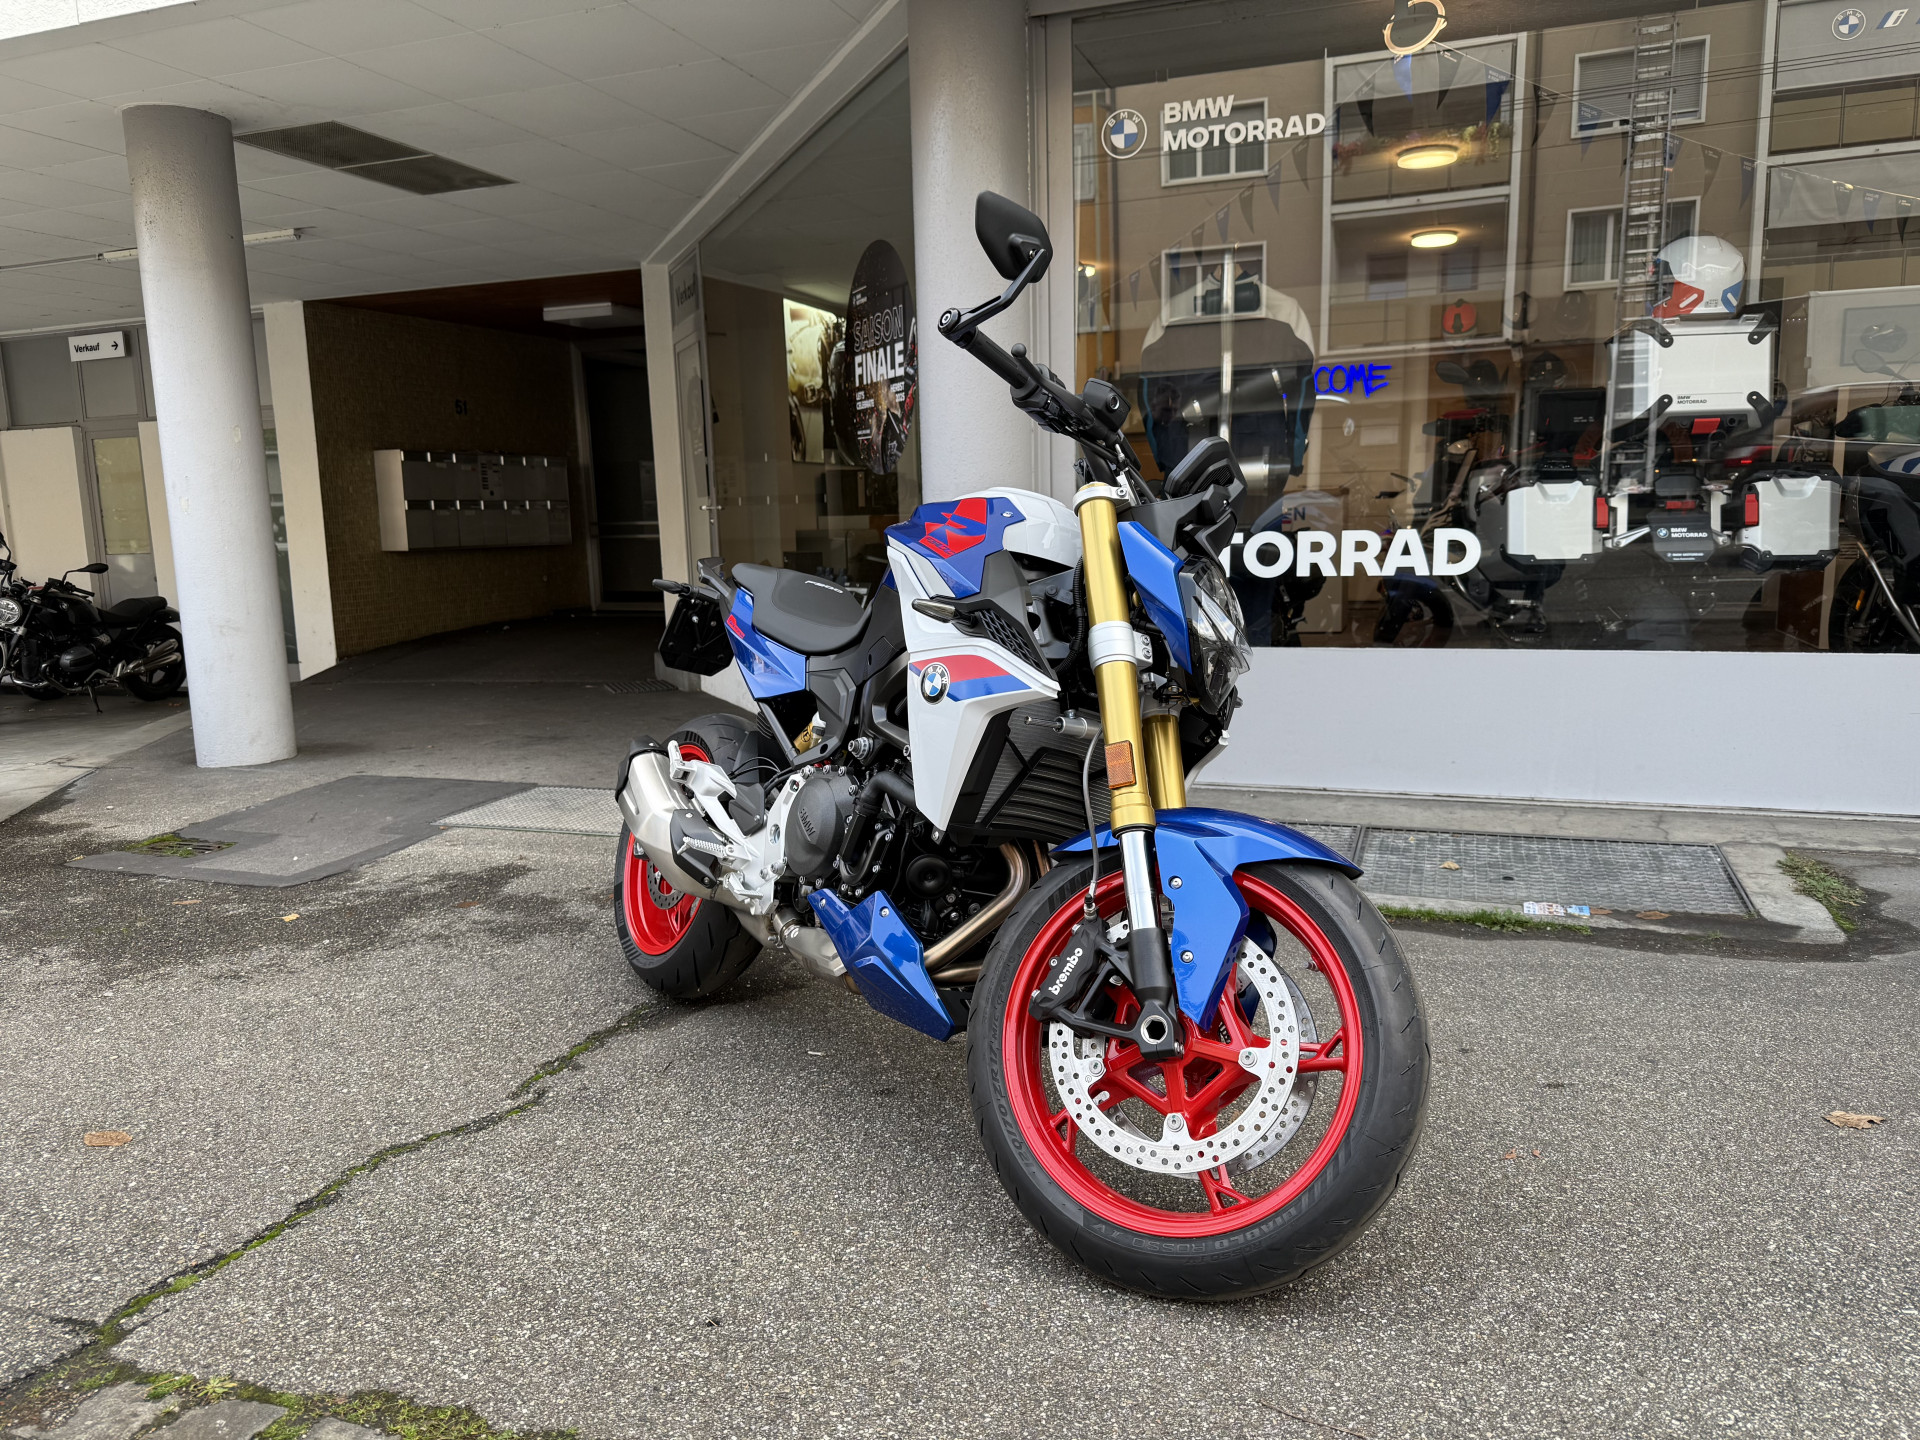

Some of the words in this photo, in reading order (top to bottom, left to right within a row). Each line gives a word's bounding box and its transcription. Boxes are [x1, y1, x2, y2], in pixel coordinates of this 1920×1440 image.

[1163, 94, 1235, 125] BMW
[1163, 112, 1326, 152] MOTORRAD
[853, 304, 904, 353] SAISON
[73, 342, 100, 353] Verkauf
[854, 341, 905, 388] FINALE
[1314, 363, 1392, 398] COME
[455, 399, 468, 415] 51
[800, 808, 816, 837] BMW
[1048, 946, 1084, 997] brembo
[1132, 1237, 1206, 1254] ROSSO
[1213, 1206, 1297, 1251] DIABLO
